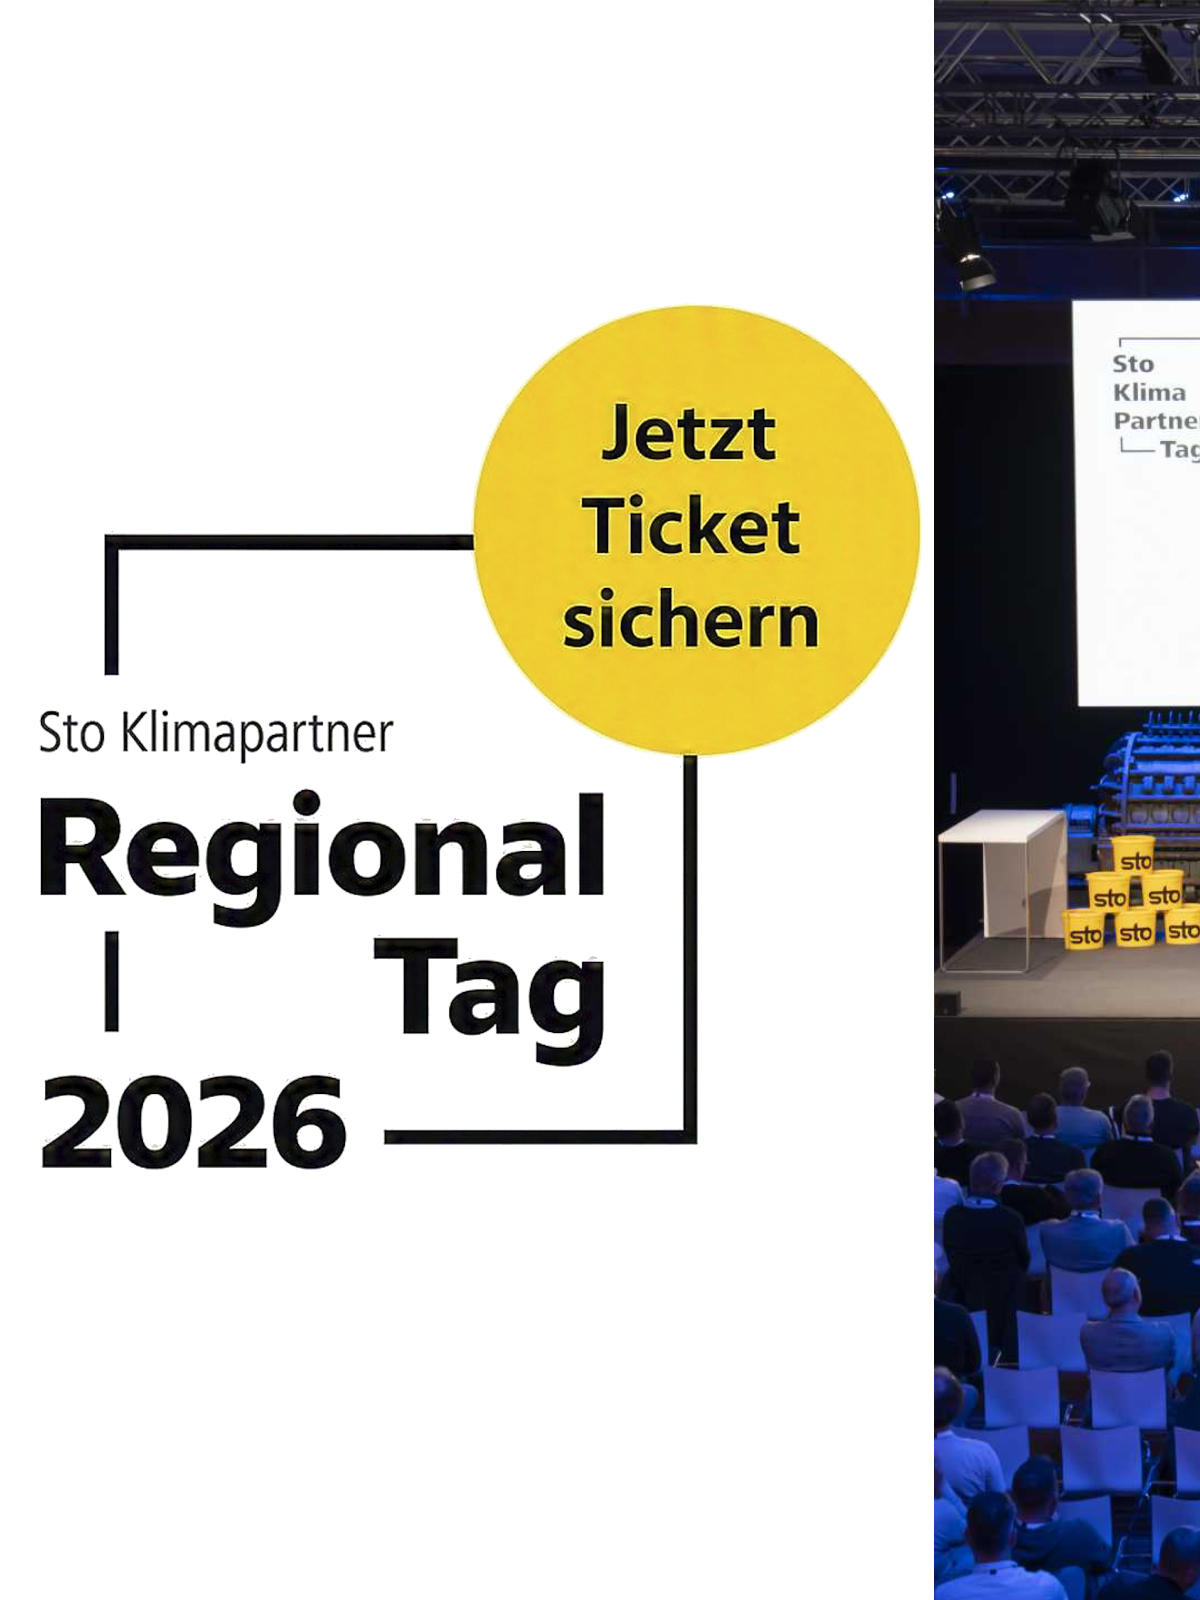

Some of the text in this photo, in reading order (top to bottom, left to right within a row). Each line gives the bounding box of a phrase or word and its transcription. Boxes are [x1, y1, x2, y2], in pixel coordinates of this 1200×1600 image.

[1113, 354, 1154, 373] Sto
[1113, 383, 1186, 402] Klima
[1121, 852, 1152, 870] sto
[1094, 888, 1126, 907] sto
[1148, 886, 1180, 905] sto
[1070, 925, 1102, 944] sto
[1120, 922, 1152, 942] sto
[1168, 921, 1200, 939] sto
